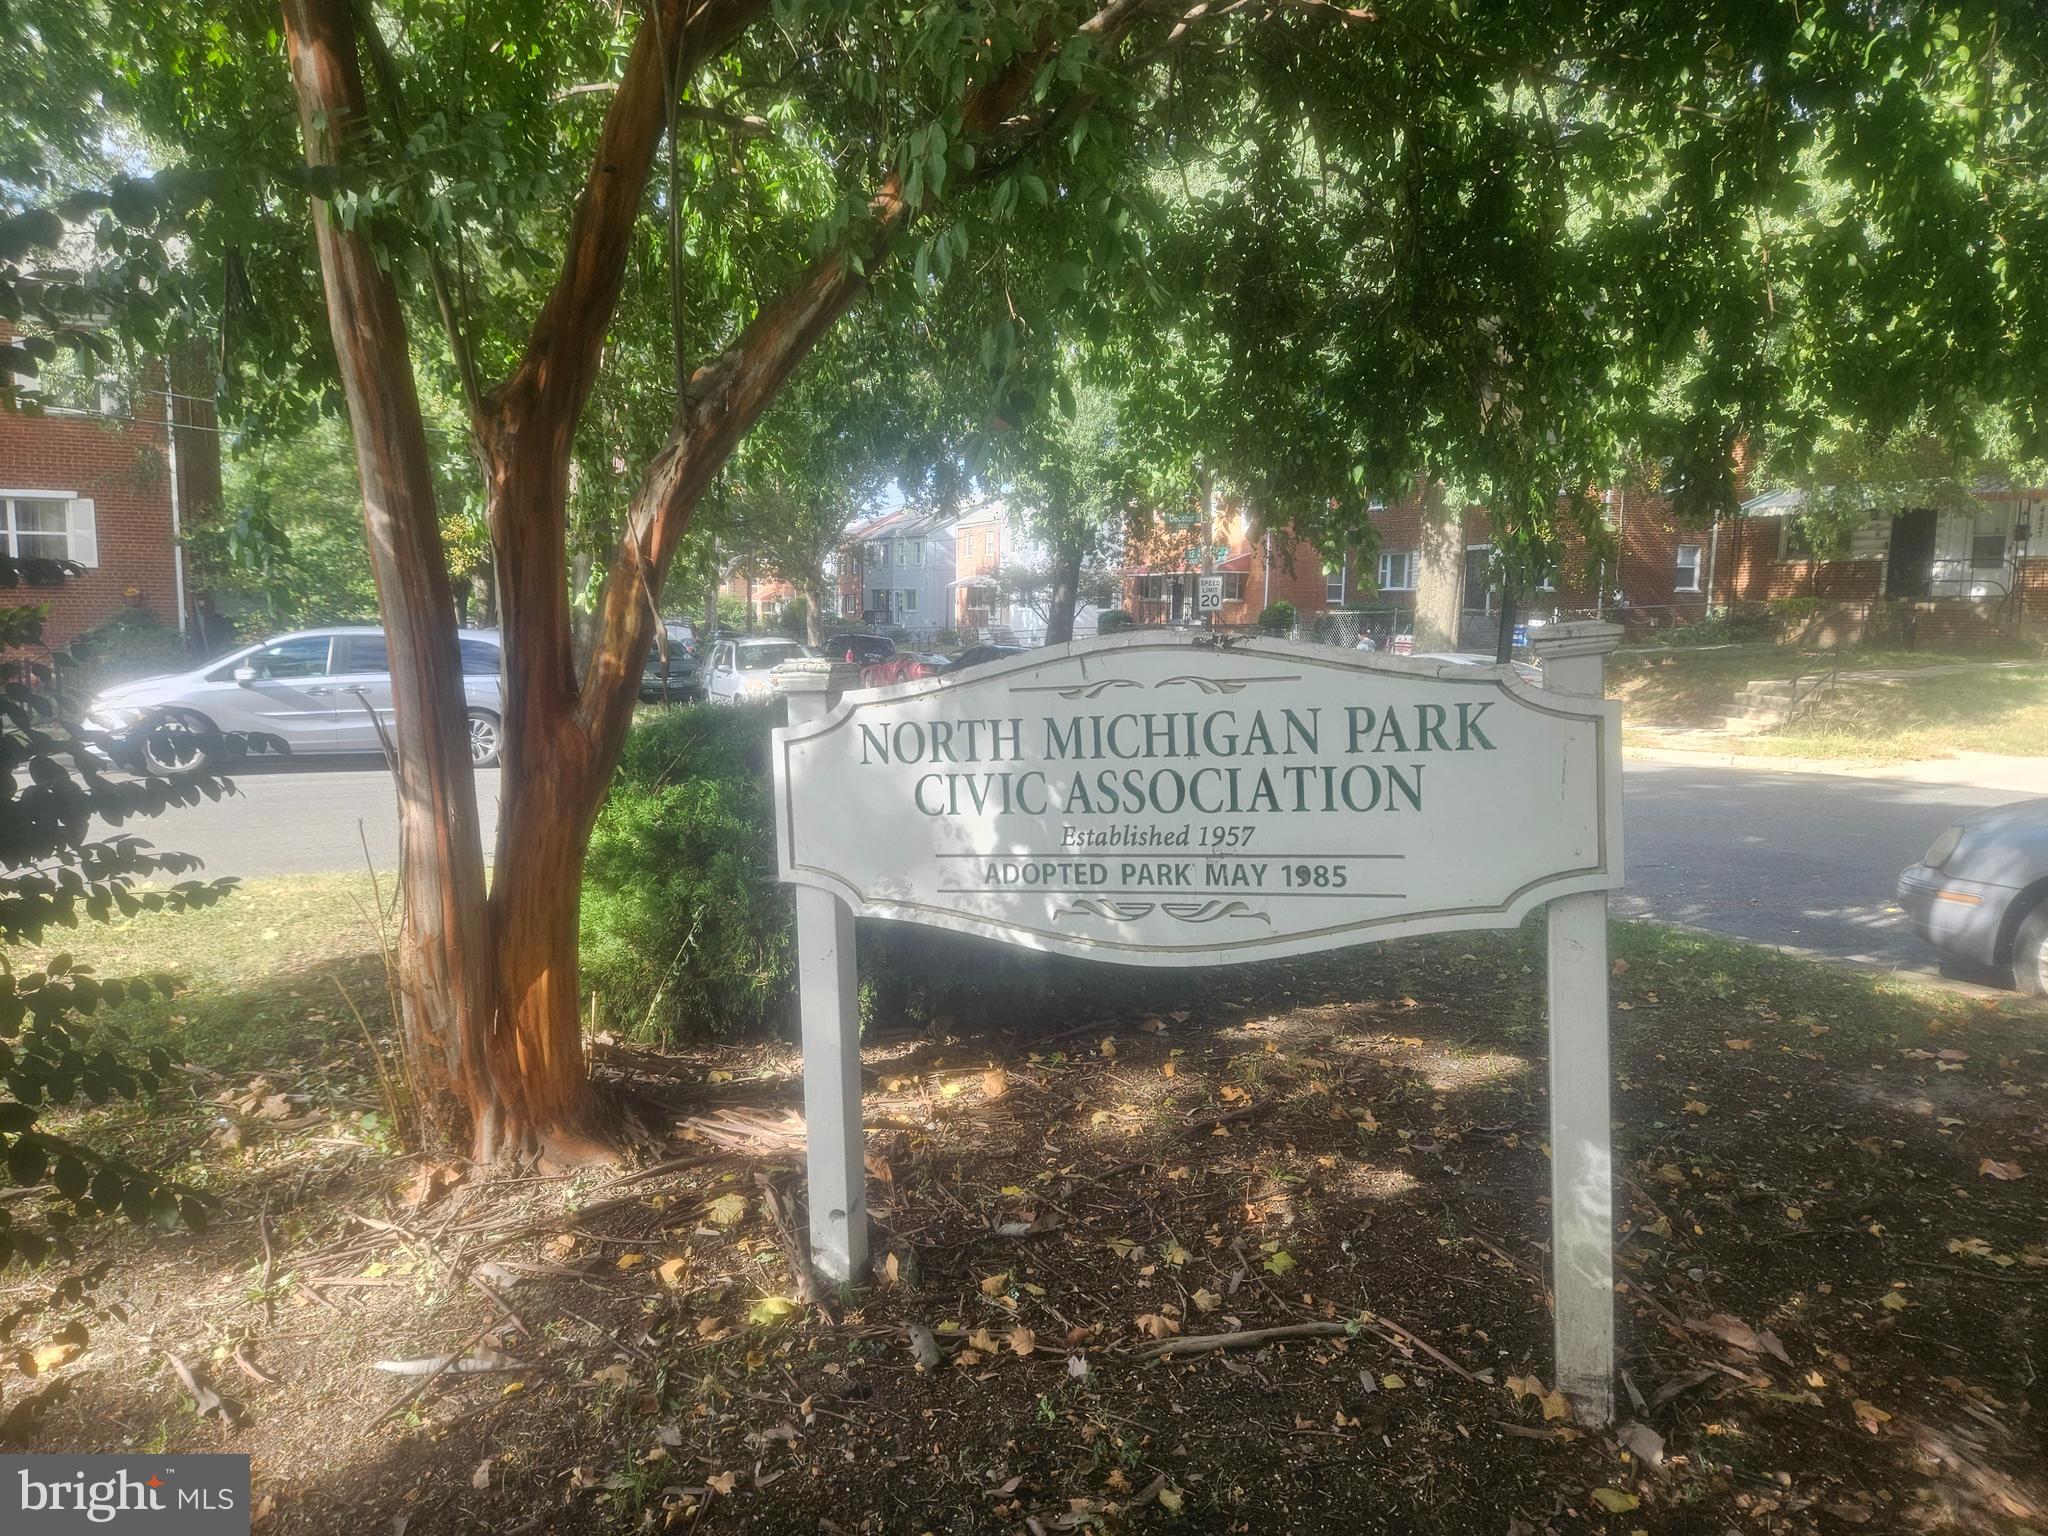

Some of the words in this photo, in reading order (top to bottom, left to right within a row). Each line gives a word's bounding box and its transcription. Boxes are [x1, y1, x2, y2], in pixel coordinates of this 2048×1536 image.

[1201, 594, 1220, 607] 20
[857, 718, 1025, 765] NORTH
[1043, 707, 1322, 760] MICHIGAN
[1344, 701, 1498, 754] PARK
[914, 771, 1048, 816] CIVIC
[1062, 763, 1426, 815] ASSOCIATION
[1060, 825, 1190, 847] Established
[1197, 825, 1256, 847] 1957
[984, 862, 1108, 886] ADOPTED
[1121, 863, 1193, 887] PARK
[1205, 864, 1268, 888] MAY
[1281, 864, 1348, 889] 1985
